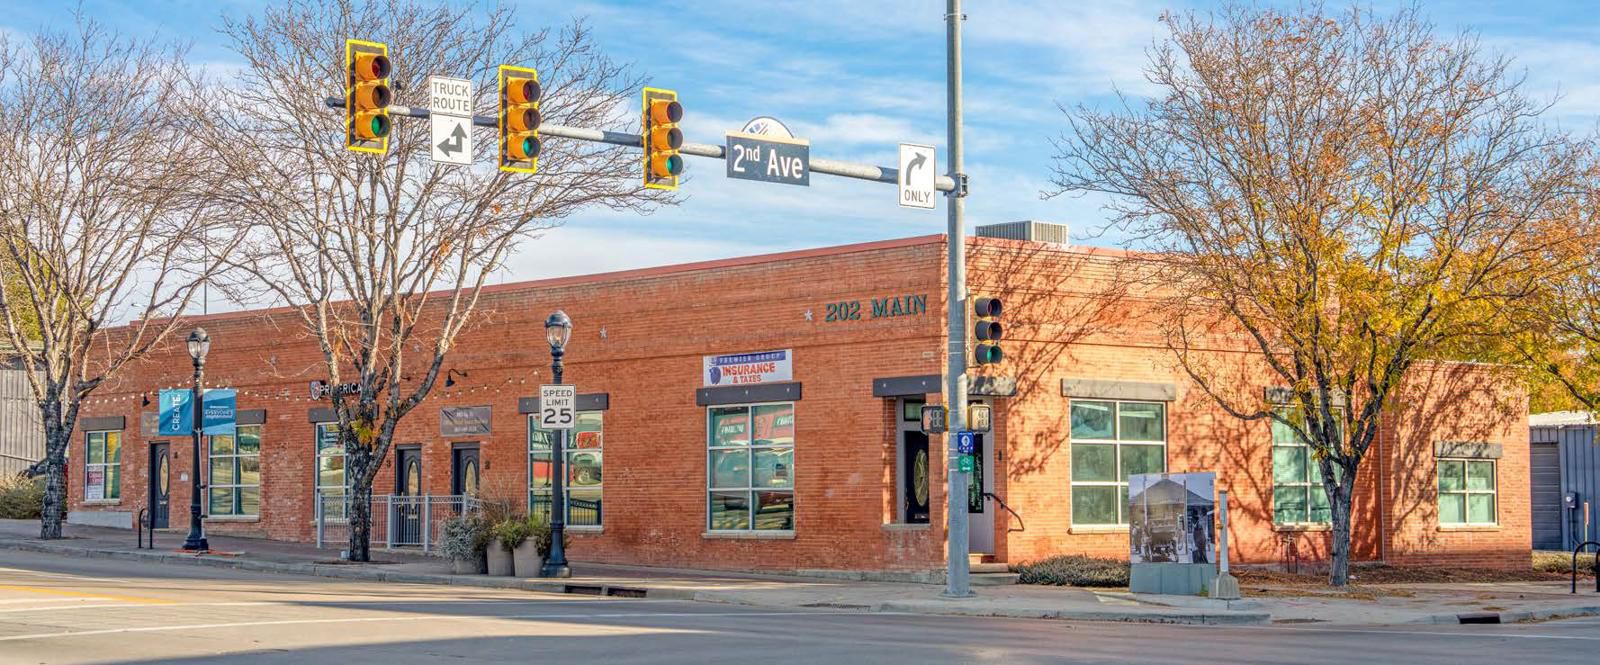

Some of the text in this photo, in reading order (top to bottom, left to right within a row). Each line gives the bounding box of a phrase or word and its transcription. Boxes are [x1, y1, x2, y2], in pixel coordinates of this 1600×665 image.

[433, 82, 469, 96] TRUCK
[433, 97, 470, 112] ROUTE
[733, 144, 803, 179] 2nd Ave
[904, 189, 931, 203] ONLY
[825, 294, 927, 322] 202 MAIN
[721, 362, 776, 377] INSURANCE
[740, 374, 761, 383] TAXES
[544, 408, 572, 424] 25
